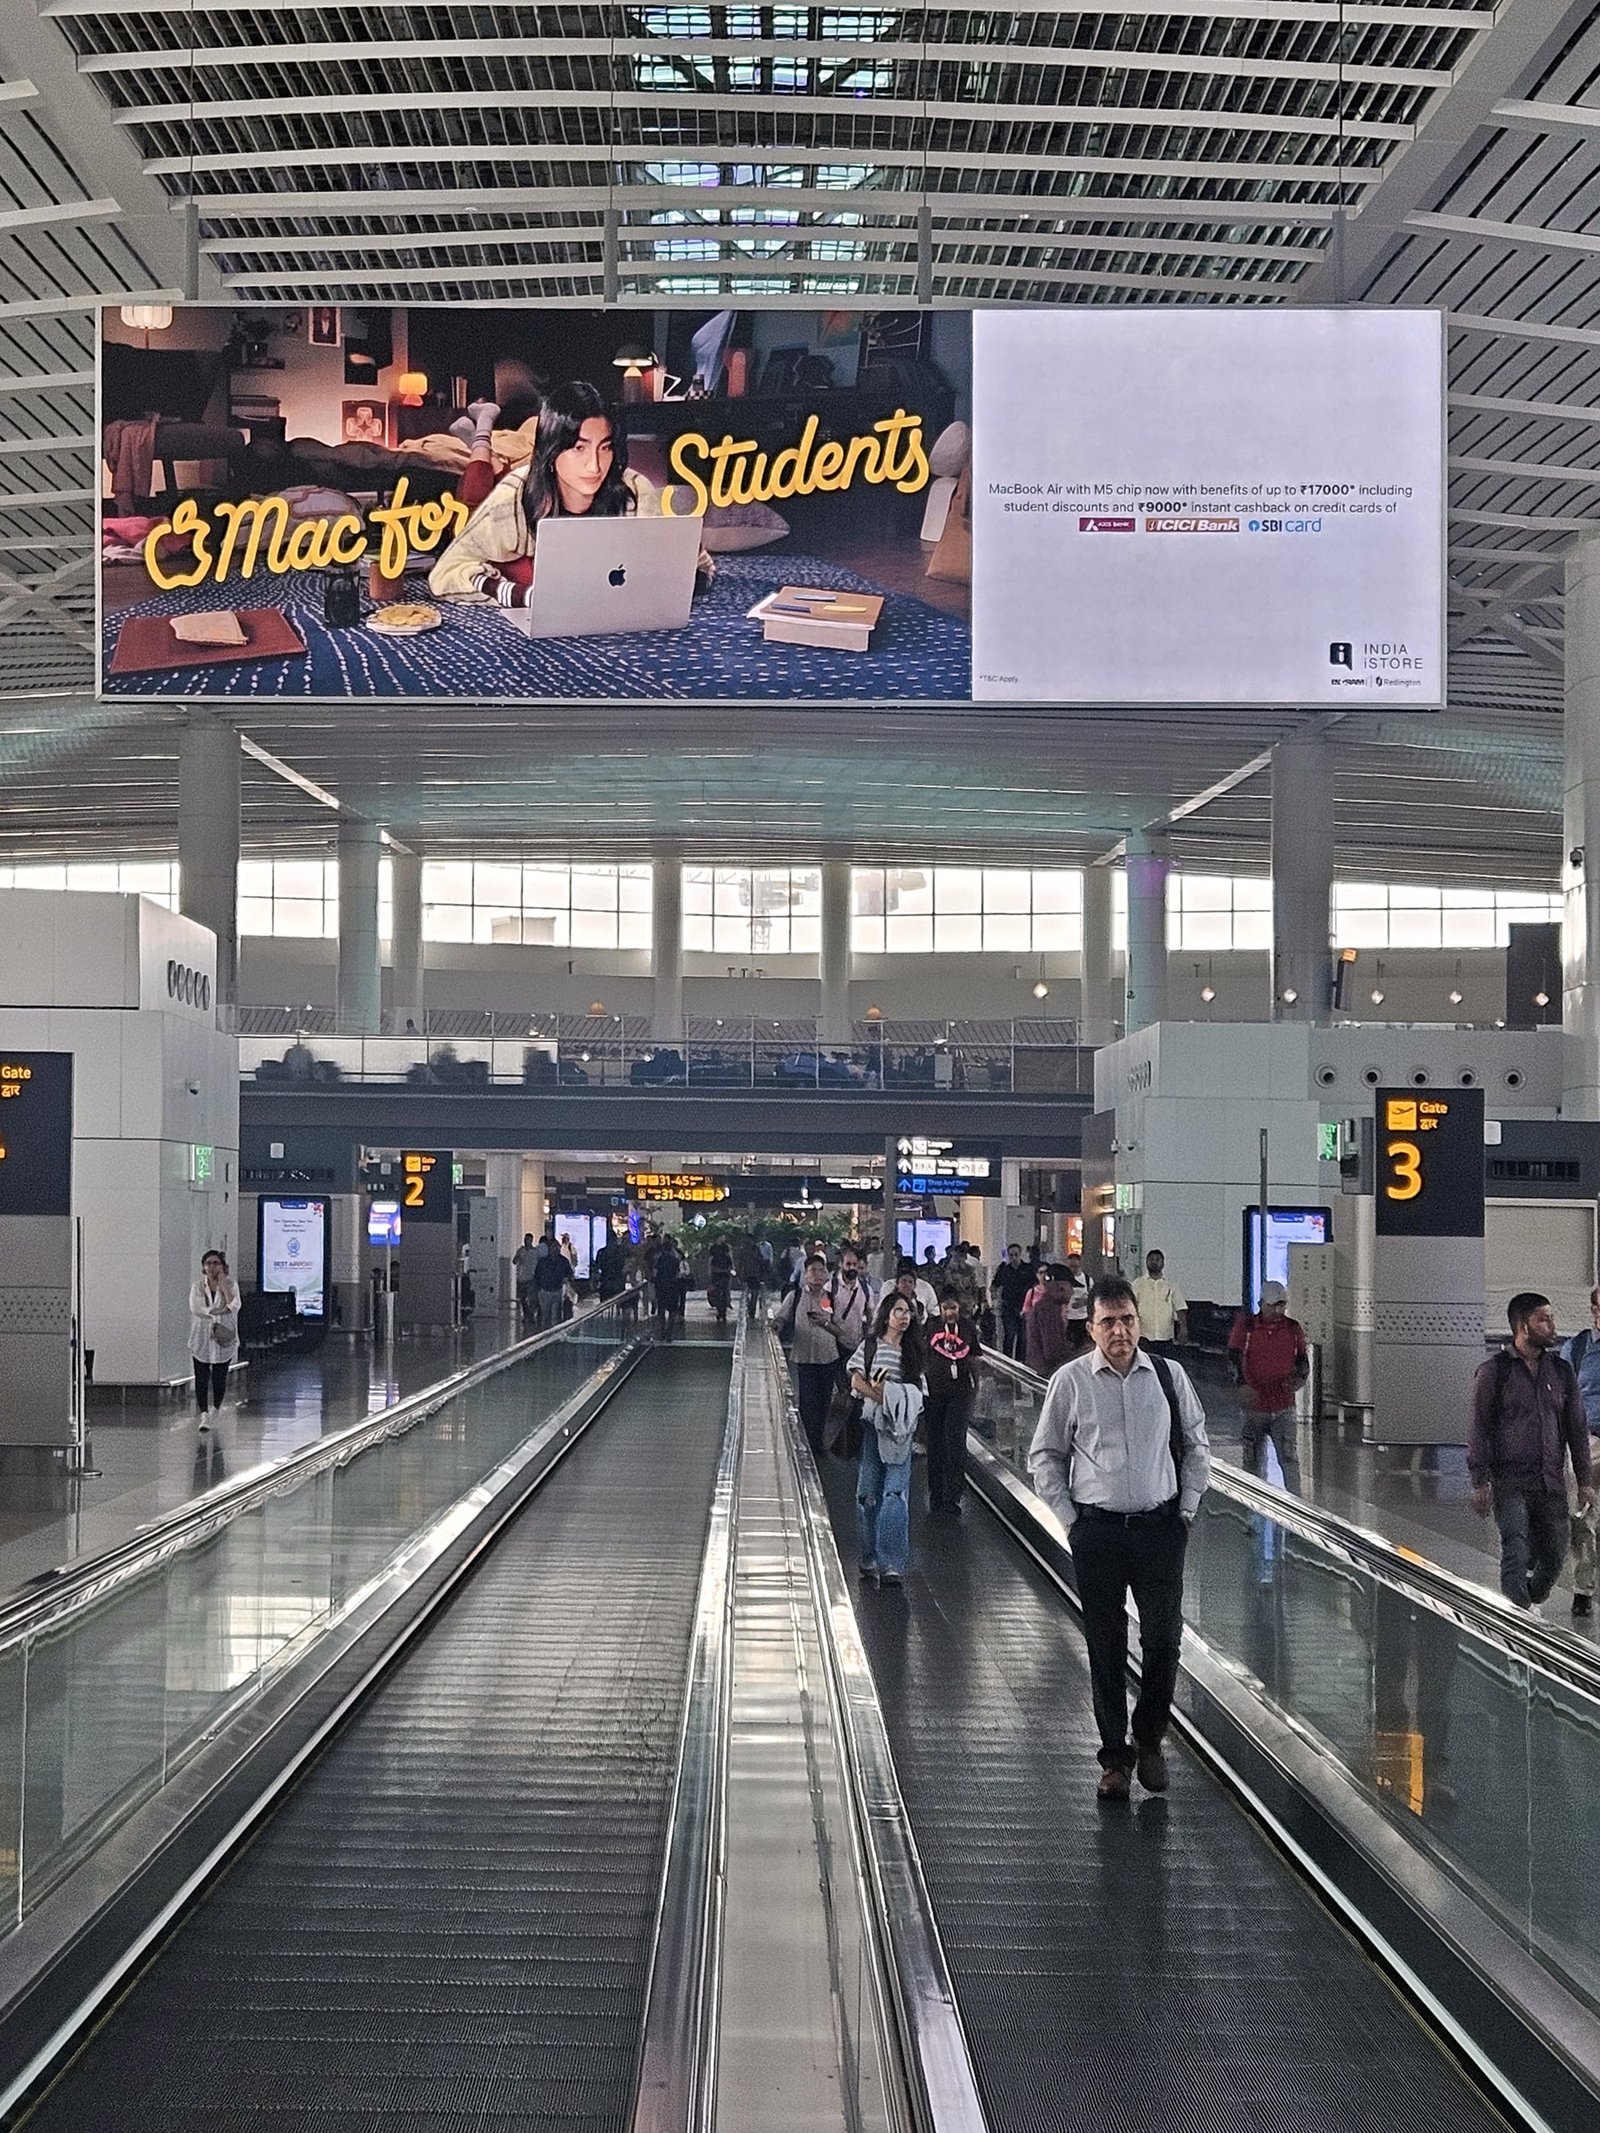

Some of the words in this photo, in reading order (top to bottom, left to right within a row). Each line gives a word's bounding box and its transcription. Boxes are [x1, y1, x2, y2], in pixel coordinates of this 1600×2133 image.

[661, 408, 930, 517] Students
[988, 484, 1044, 495] MacBook
[1046, 484, 1062, 495] Air
[1066, 484, 1090, 495] with
[1094, 484, 1113, 495] M5
[1116, 484, 1142, 497] chip
[1145, 487, 1170, 496] now
[1172, 484, 1197, 495] with
[1200, 484, 1248, 496] benefits
[1251, 484, 1263, 495] of
[1266, 487, 1281, 498] up
[1285, 486, 1296, 496] to
[1358, 484, 1412, 498] including
[1003, 501, 1049, 512] student
[1052, 501, 1109, 513] discounts
[1113, 501, 1134, 512] and
[1191, 502, 1231, 513] instant
[1234, 502, 1291, 513] cashback
[1294, 505, 1309, 513] on
[1312, 502, 1346, 513] credit
[1349, 502, 1382, 513] cards
[1385, 502, 1397, 513] of
[213, 497, 368, 583] Mac
[369, 477, 469, 579] for
[1156, 519, 1196, 531] ICICI
[1197, 519, 1239, 532] Bank
[1261, 519, 1282, 532] SBI
[1285, 518, 1322, 532] card
[1364, 643, 1408, 655] INDIA
[1364, 657, 1423, 669] iSTORE
[1, 1066, 32, 1079] Gate
[1, 1084, 21, 1098] द्वार
[1419, 1102, 1448, 1114] Gate
[1387, 1142, 1422, 1200] 3
[659, 1174, 690, 1186] 31-45
[405, 1176, 425, 1206] 2
[660, 1188, 692, 1200] 31-45
